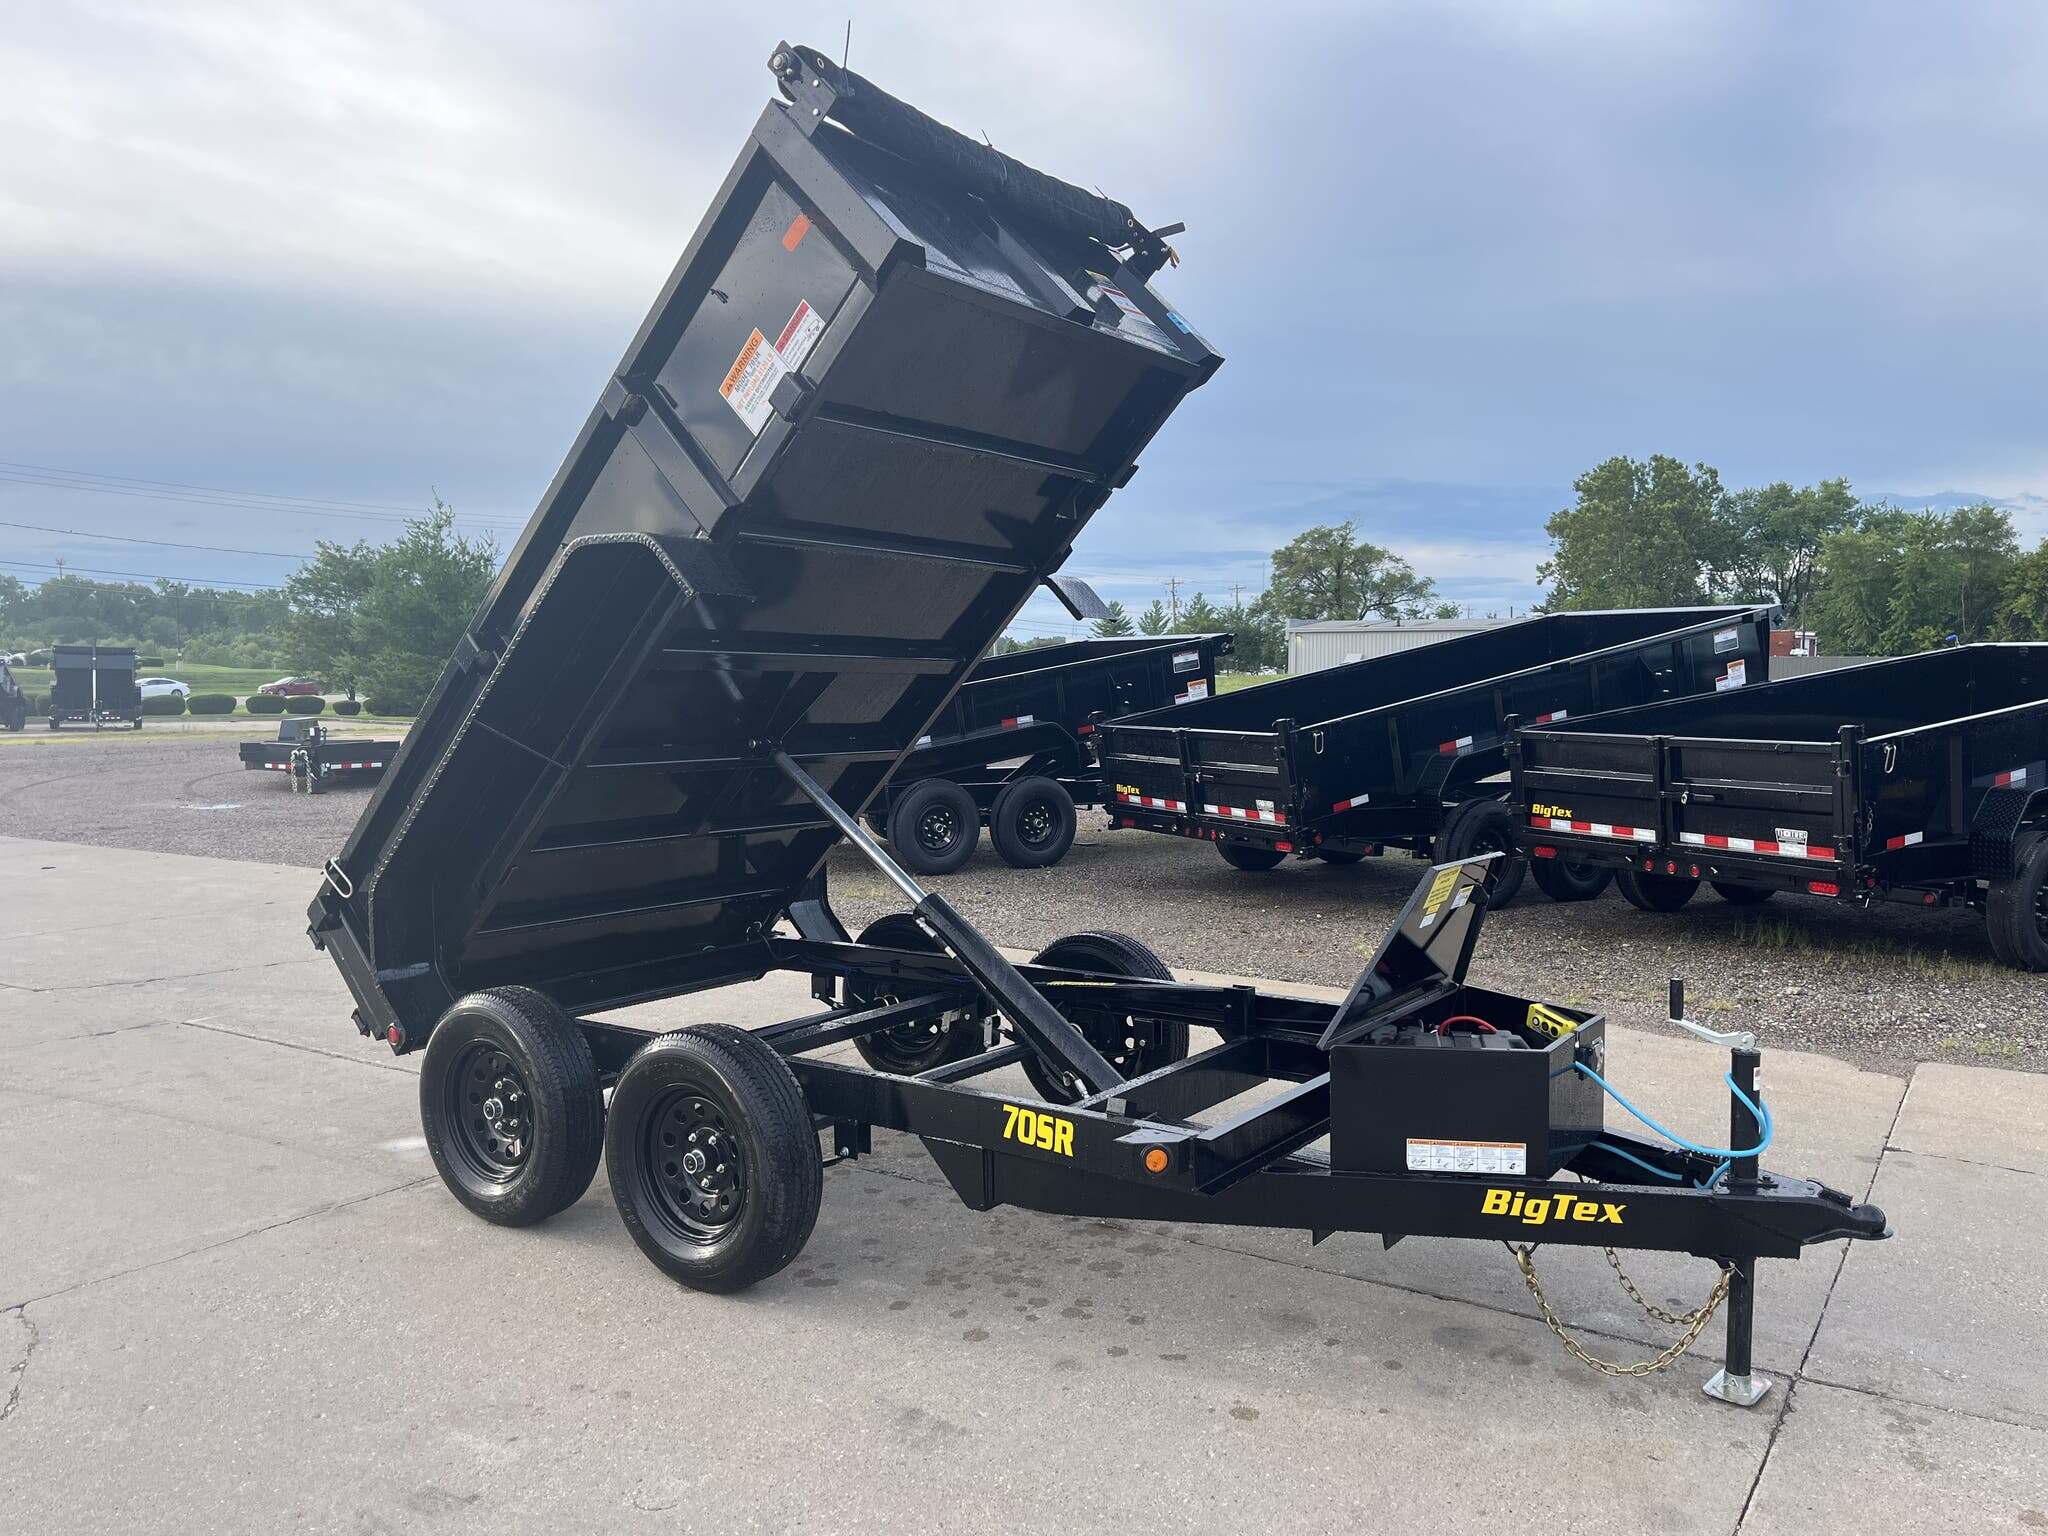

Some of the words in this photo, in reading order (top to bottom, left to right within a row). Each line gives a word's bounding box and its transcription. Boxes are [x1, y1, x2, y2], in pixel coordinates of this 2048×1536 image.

[729, 337, 759, 384] WARNING
[734, 368, 750, 393] MODEL
[1116, 783, 1141, 795] BigTex
[1532, 803, 1573, 818] BigTex
[1002, 1103, 1074, 1157] 70SR
[1480, 1188, 1628, 1225] BigTex
